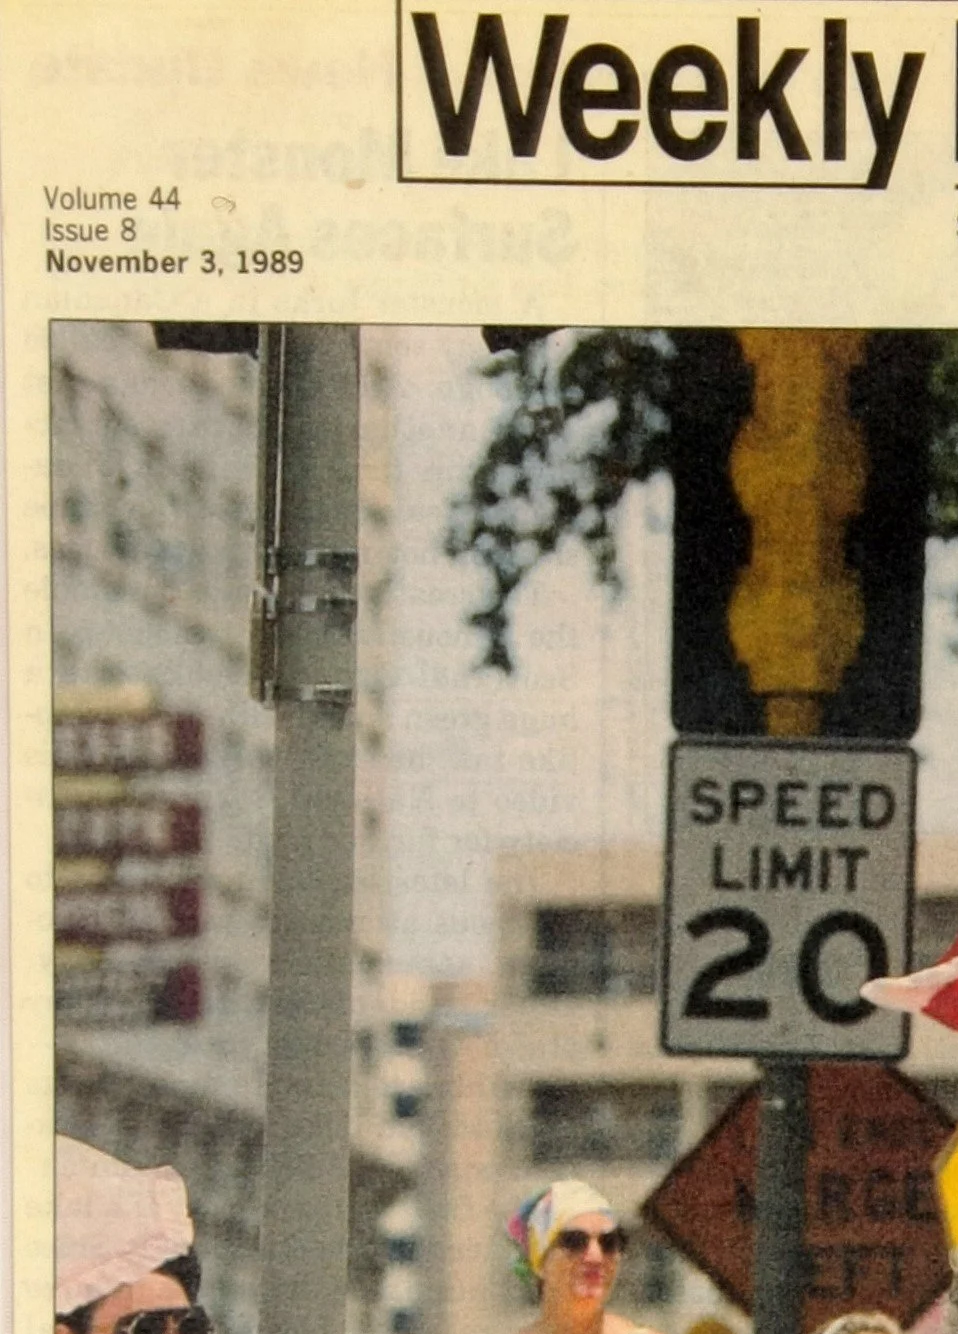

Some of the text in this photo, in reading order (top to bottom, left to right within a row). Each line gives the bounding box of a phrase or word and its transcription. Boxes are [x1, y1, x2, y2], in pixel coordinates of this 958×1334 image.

[409, 11, 926, 188] Weekly
[44, 185, 181, 211] Volume 44
[45, 218, 136, 242] Issue 8
[46, 250, 303, 277] November 3, 1989
[689, 777, 897, 831] SPEED
[711, 844, 870, 893] LIMIT
[681, 905, 890, 1027] 20
